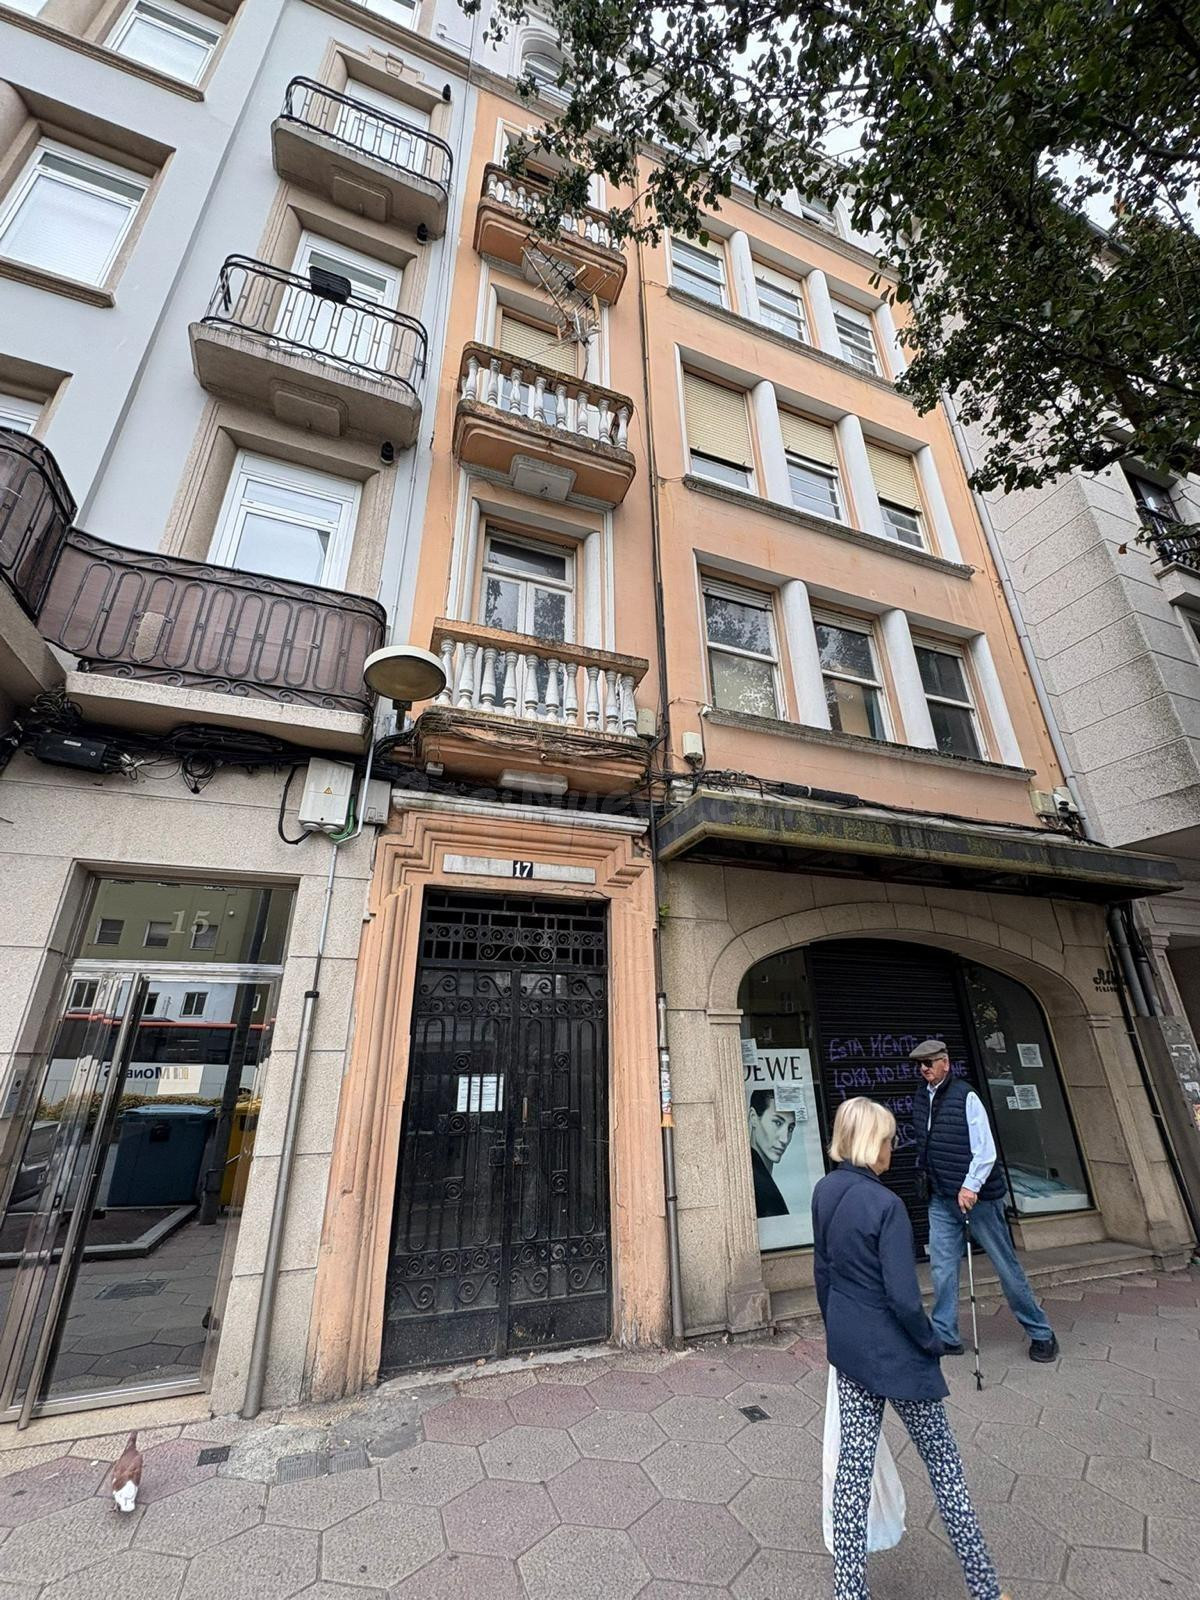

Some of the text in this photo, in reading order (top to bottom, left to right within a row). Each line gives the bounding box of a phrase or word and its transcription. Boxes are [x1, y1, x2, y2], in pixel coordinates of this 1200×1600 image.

[514, 861, 532, 878] 17
[169, 910, 211, 935] 15
[744, 1056, 804, 1082] EWE
